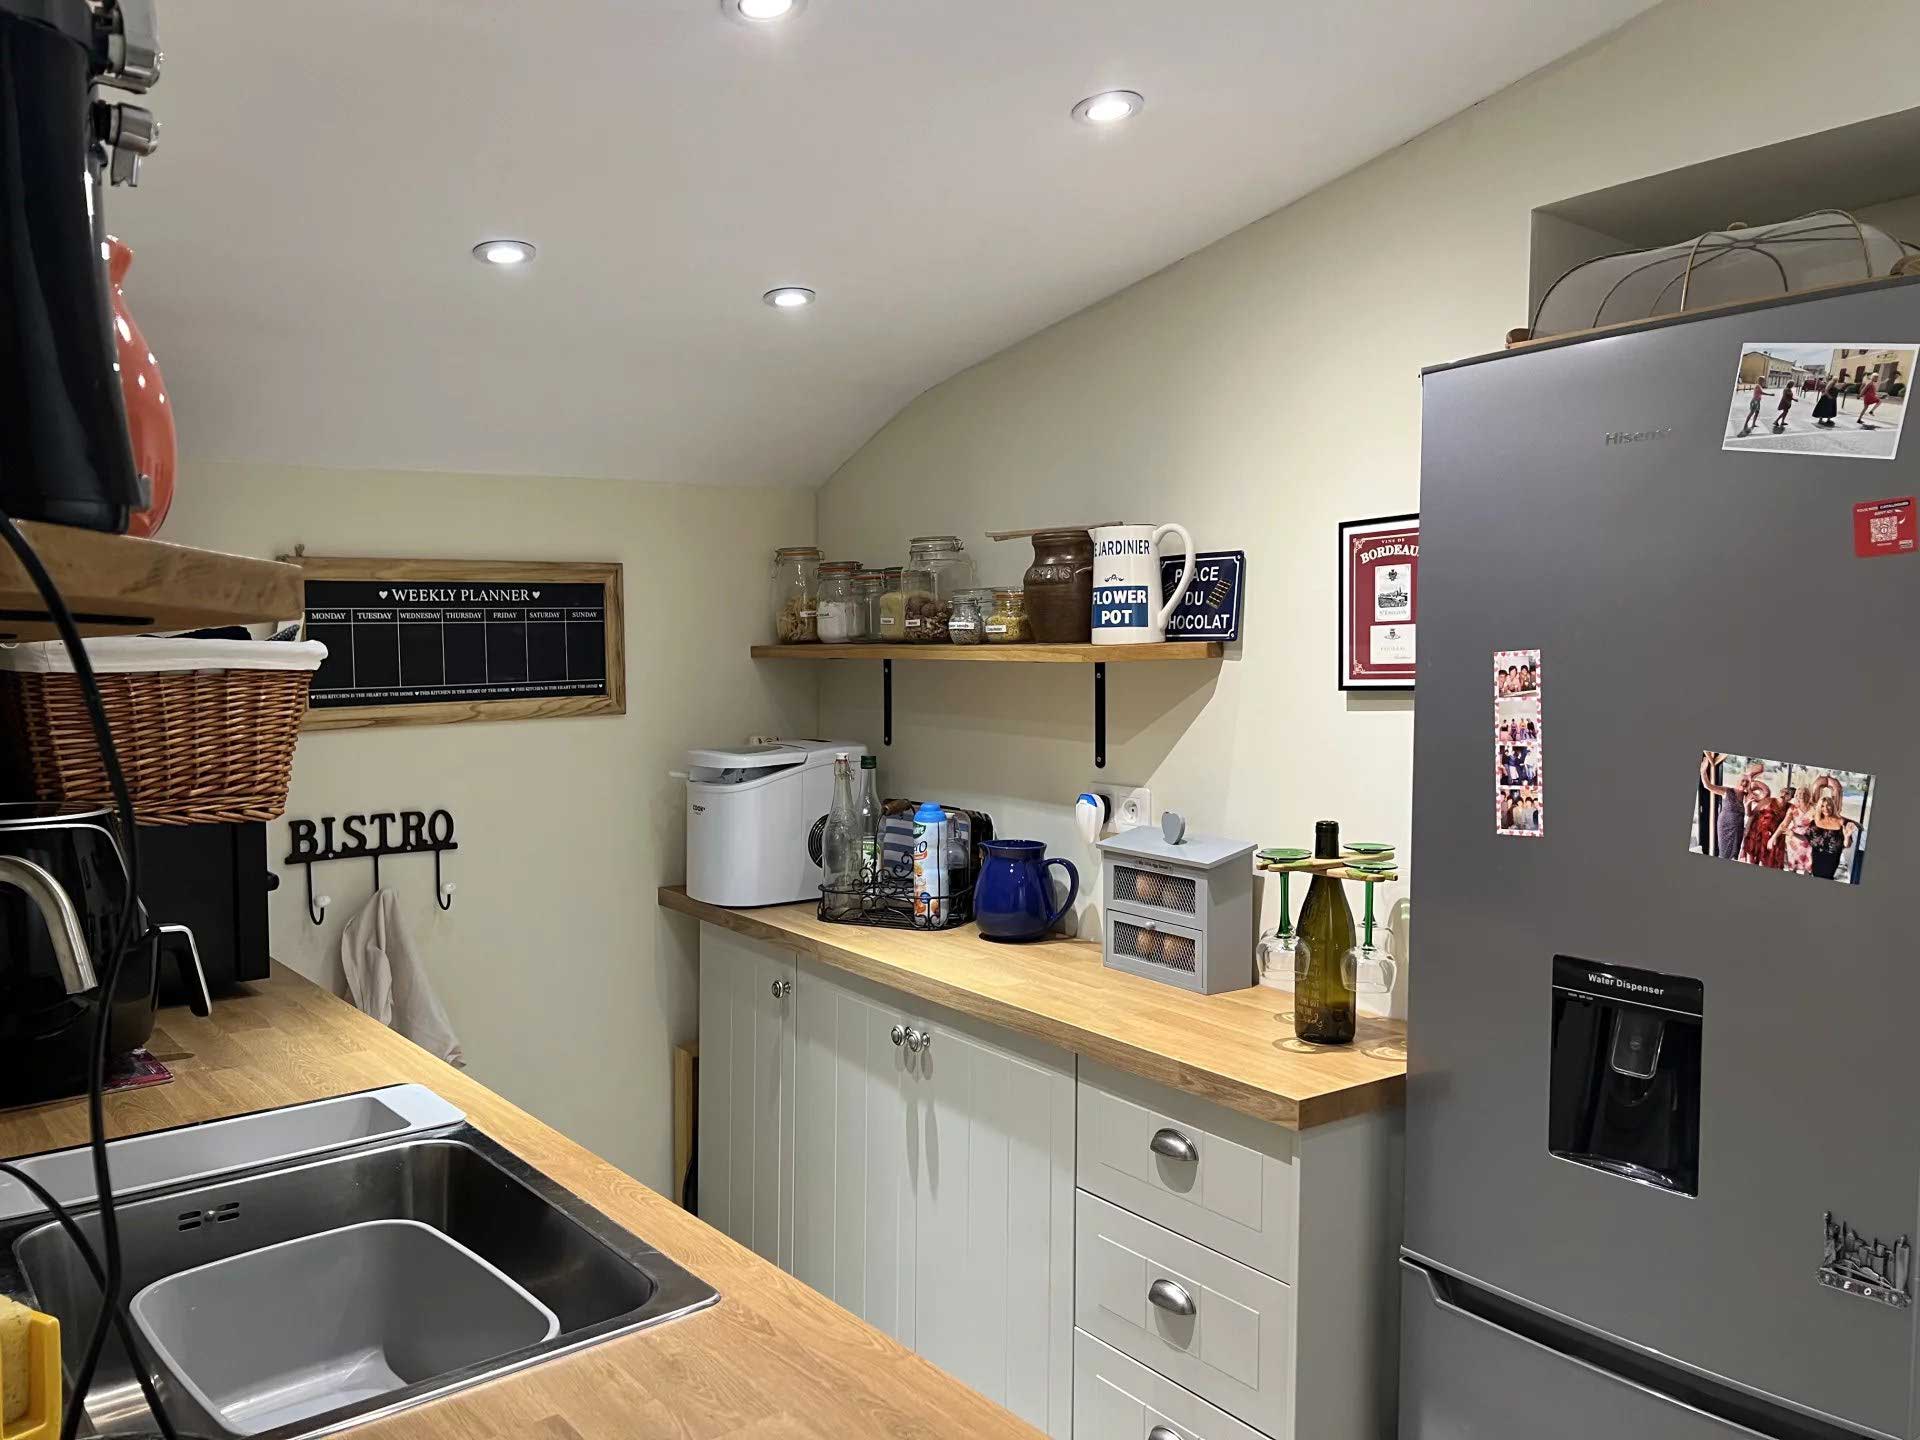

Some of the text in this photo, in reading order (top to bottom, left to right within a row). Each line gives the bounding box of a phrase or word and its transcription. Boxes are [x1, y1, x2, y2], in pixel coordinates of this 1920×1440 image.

[1099, 540, 1150, 557] JARDINIER
[1360, 544, 1420, 564] BORDEAU
[1175, 566, 1220, 584] PACE
[391, 588, 530, 602] WEEKLY PLANNER
[1093, 590, 1147, 605] FLOWER
[1185, 591, 1204, 606] DU
[312, 612, 346, 620] MONDAY
[357, 612, 392, 620] TUESDAY
[400, 611, 442, 620] WEDNESDAY
[446, 611, 483, 620] THURSDAY
[493, 611, 518, 620] FRIDAY
[529, 610, 561, 619] SATURDAY
[572, 610, 598, 618] SUNDAY
[1101, 609, 1133, 625] POT
[1168, 613, 1230, 629] HOCOLAT
[288, 809, 454, 857] BISTRO
[1588, 973, 1664, 995] Water Dispenser
